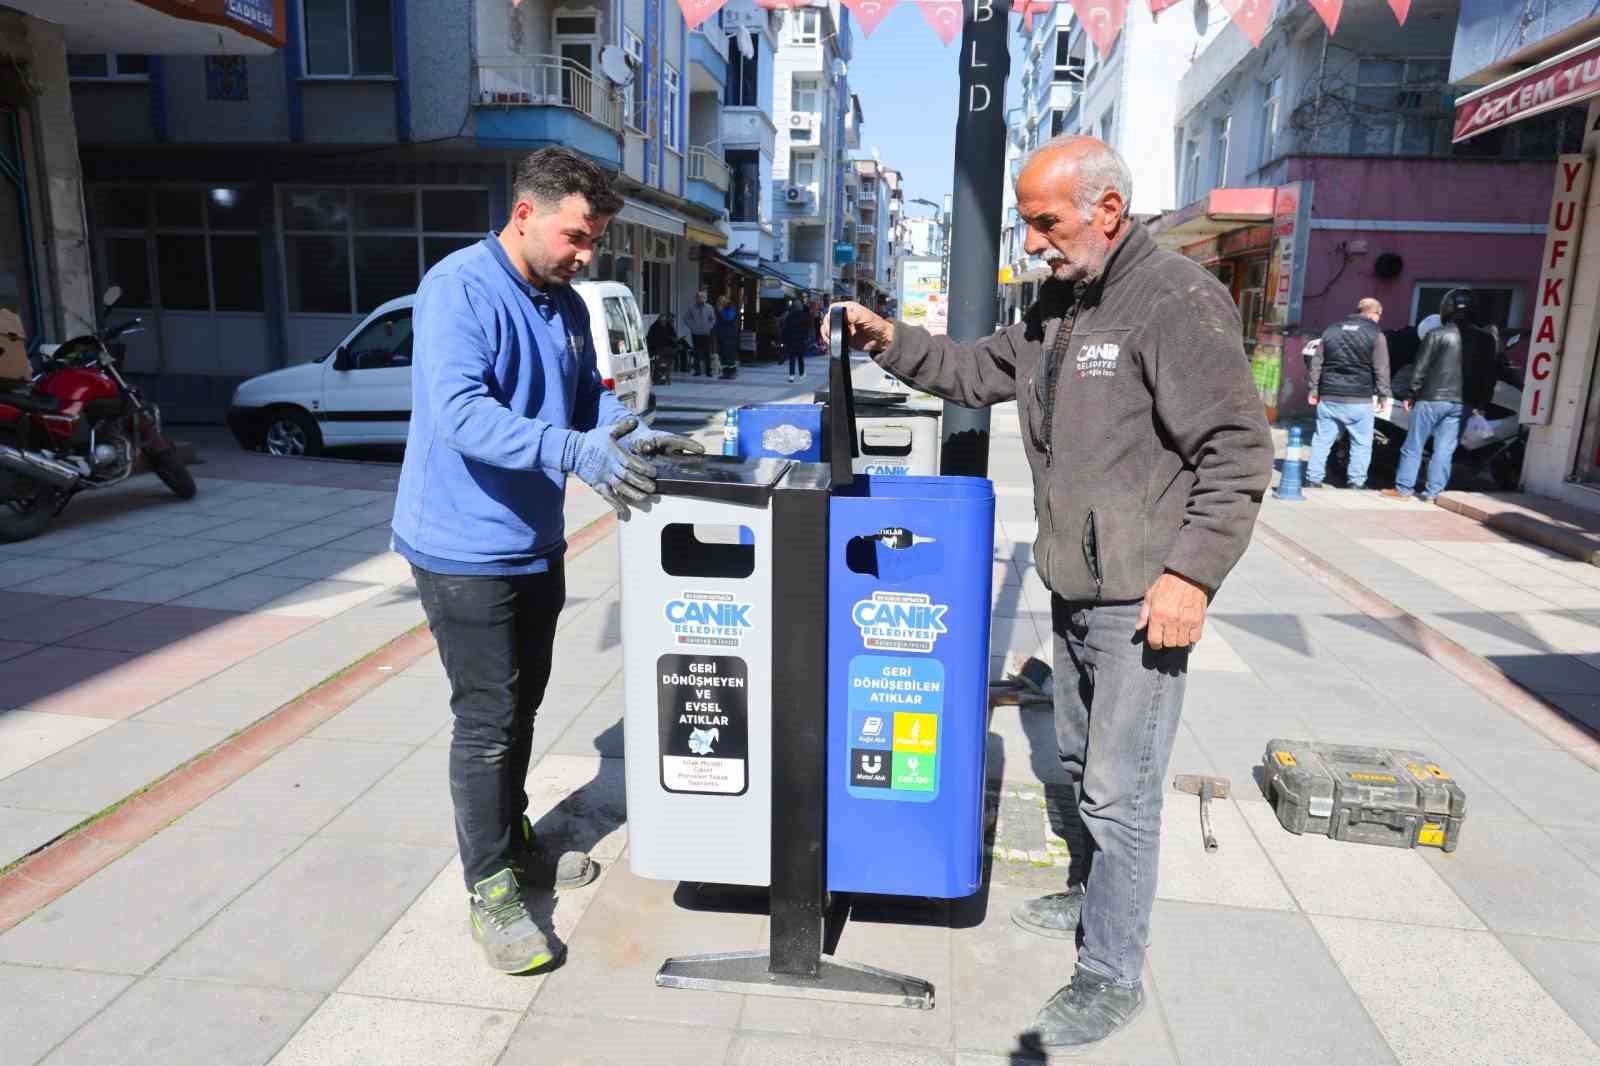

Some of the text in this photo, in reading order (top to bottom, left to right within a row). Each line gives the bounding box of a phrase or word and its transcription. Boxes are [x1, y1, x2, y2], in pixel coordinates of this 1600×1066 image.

[1471, 70, 1560, 126] ÖZLEM
[1532, 162, 1582, 416] YUFKACI
[688, 661, 717, 674] GERİ
[882, 665, 912, 677] GERİ
[662, 673, 744, 688] DÖNÜŞMEYEN
[696, 690, 712, 699] VE
[870, 691, 922, 705] ATIKLAR
[685, 702, 722, 713] EVSEL
[679, 714, 729, 726] ATIKLAR
